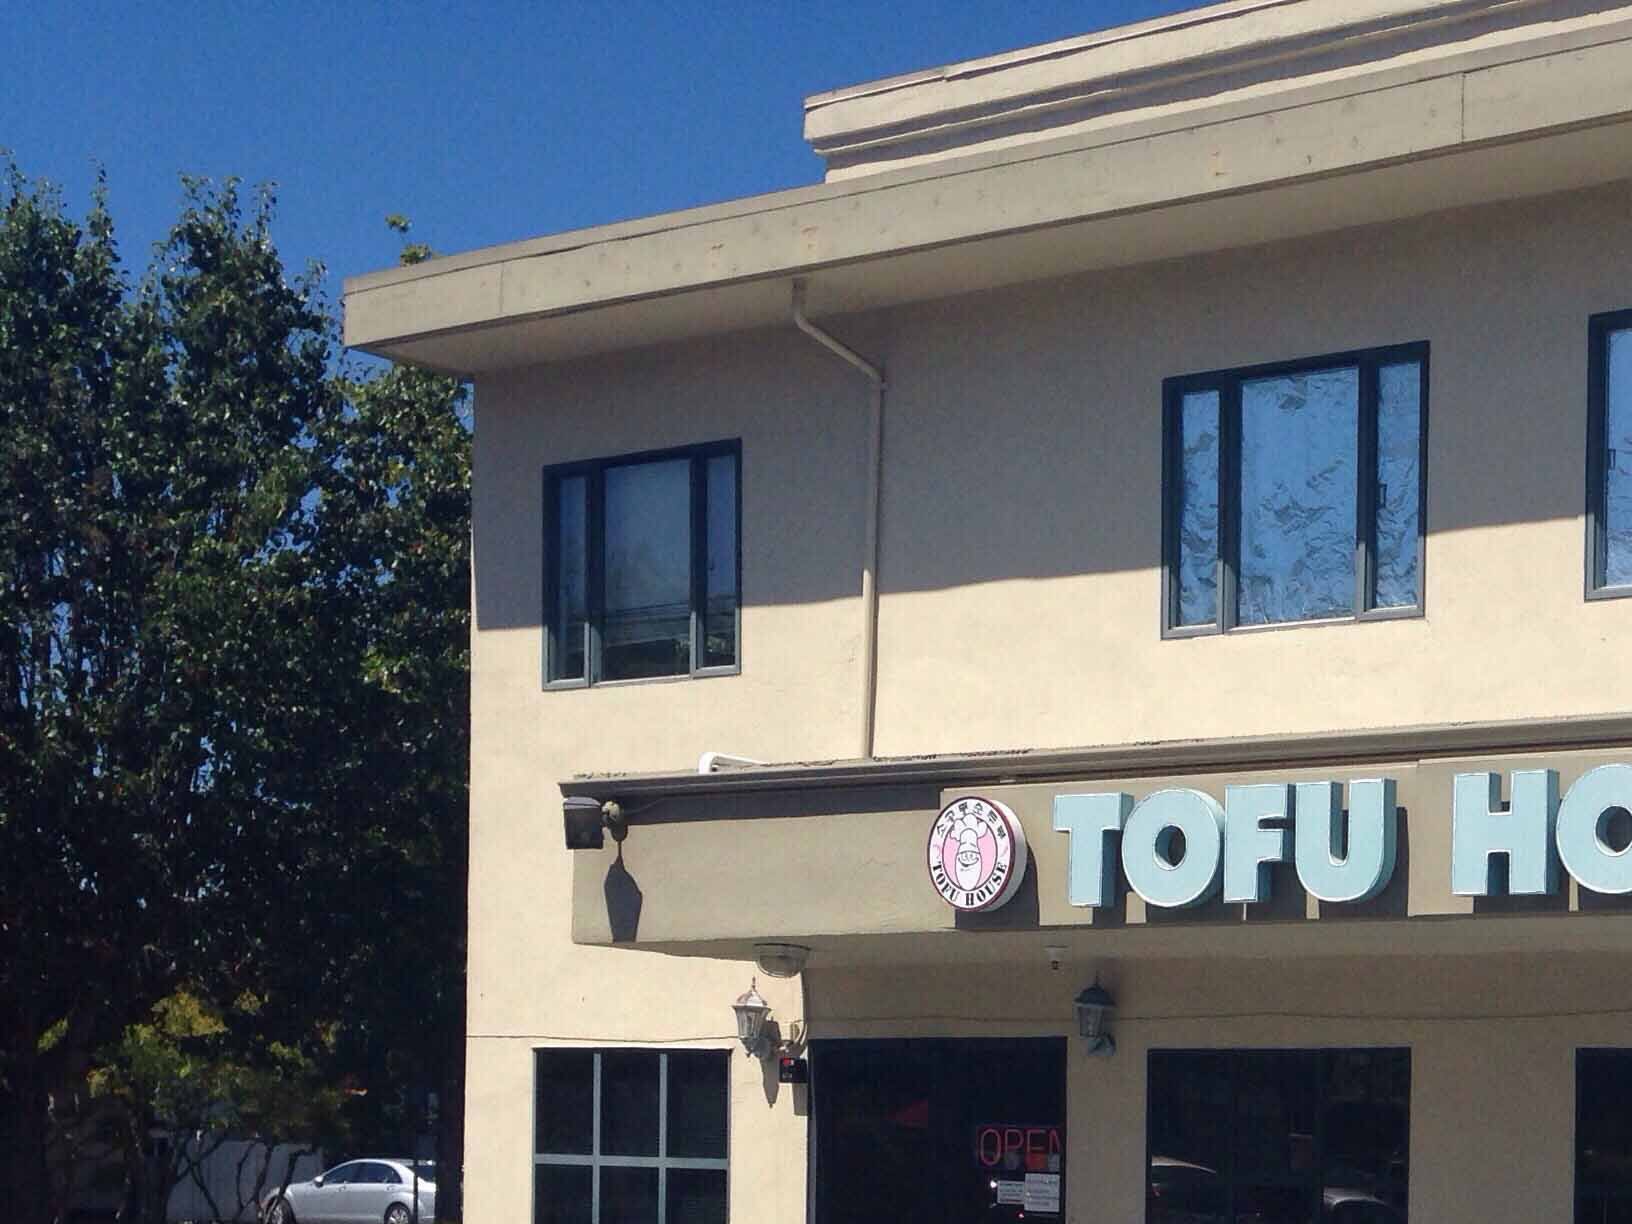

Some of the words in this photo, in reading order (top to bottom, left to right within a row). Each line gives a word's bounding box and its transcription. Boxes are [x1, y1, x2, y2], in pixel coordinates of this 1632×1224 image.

[932, 861, 960, 901] TOFU
[965, 861, 1008, 906] HOUSE
[1053, 777, 1397, 908] TOFU
